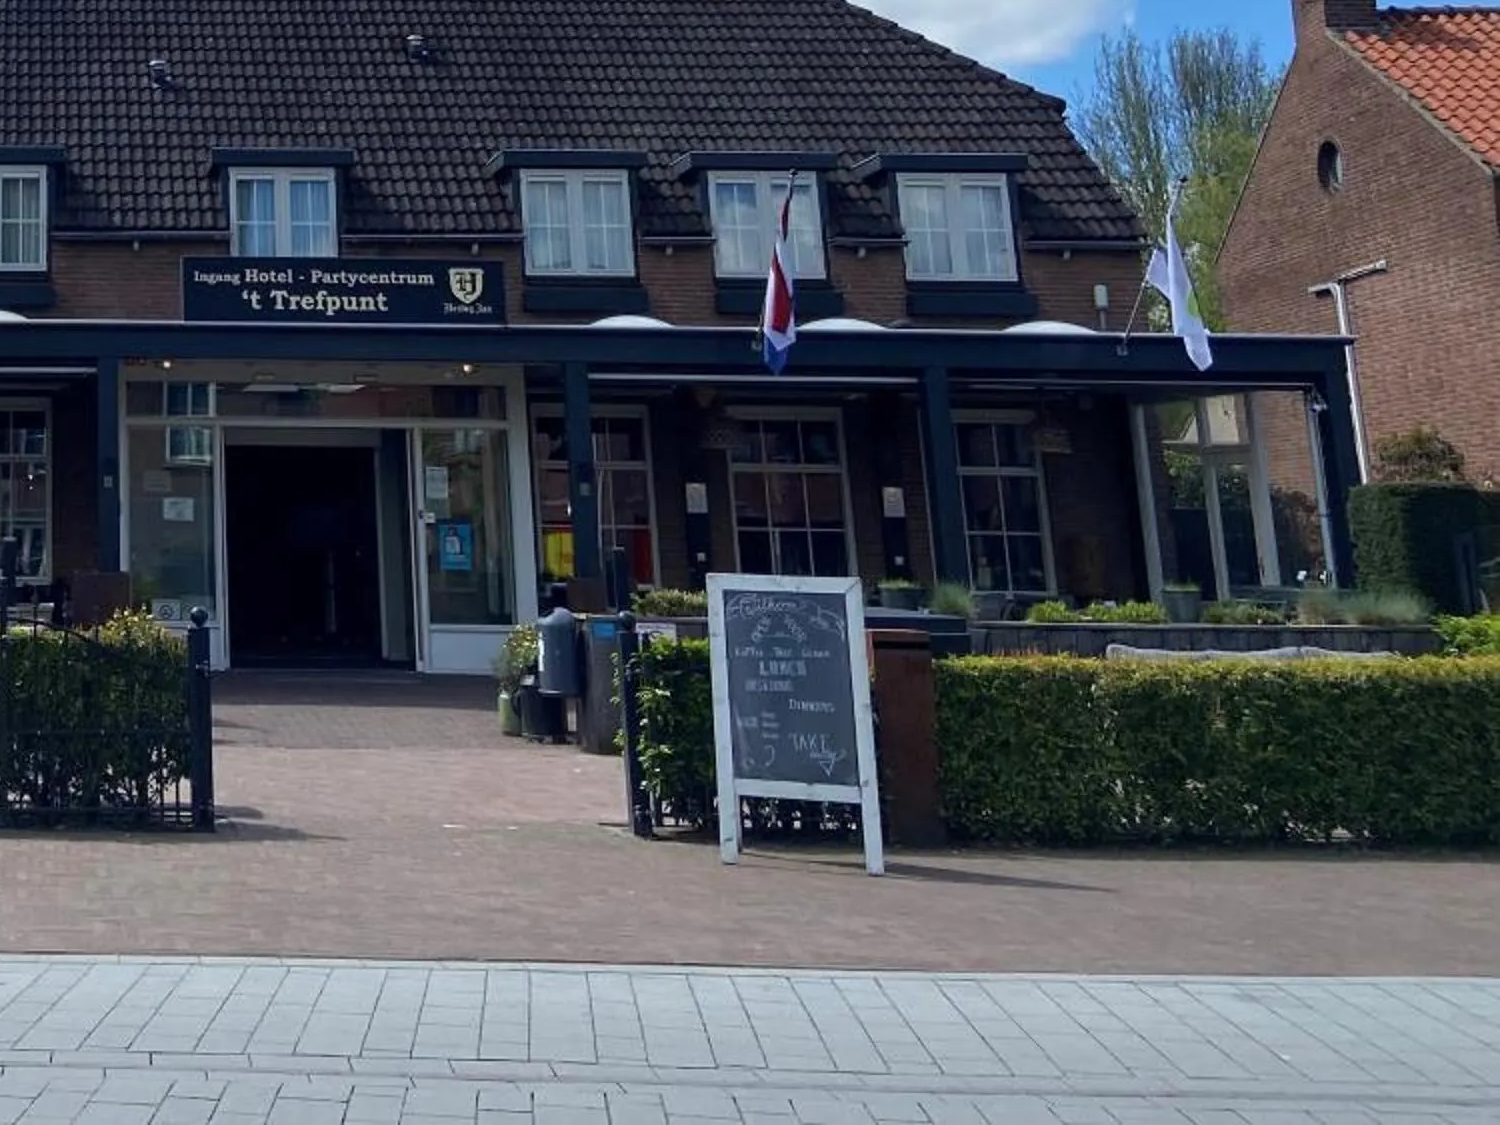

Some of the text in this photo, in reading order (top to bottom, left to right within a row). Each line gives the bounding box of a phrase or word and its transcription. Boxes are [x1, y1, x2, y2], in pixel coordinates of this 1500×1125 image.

[194, 271, 241, 284] Ingang
[244, 269, 294, 284] Hotel
[310, 270, 434, 287] Partycentrum
[269, 290, 389, 315] Trefpunt
